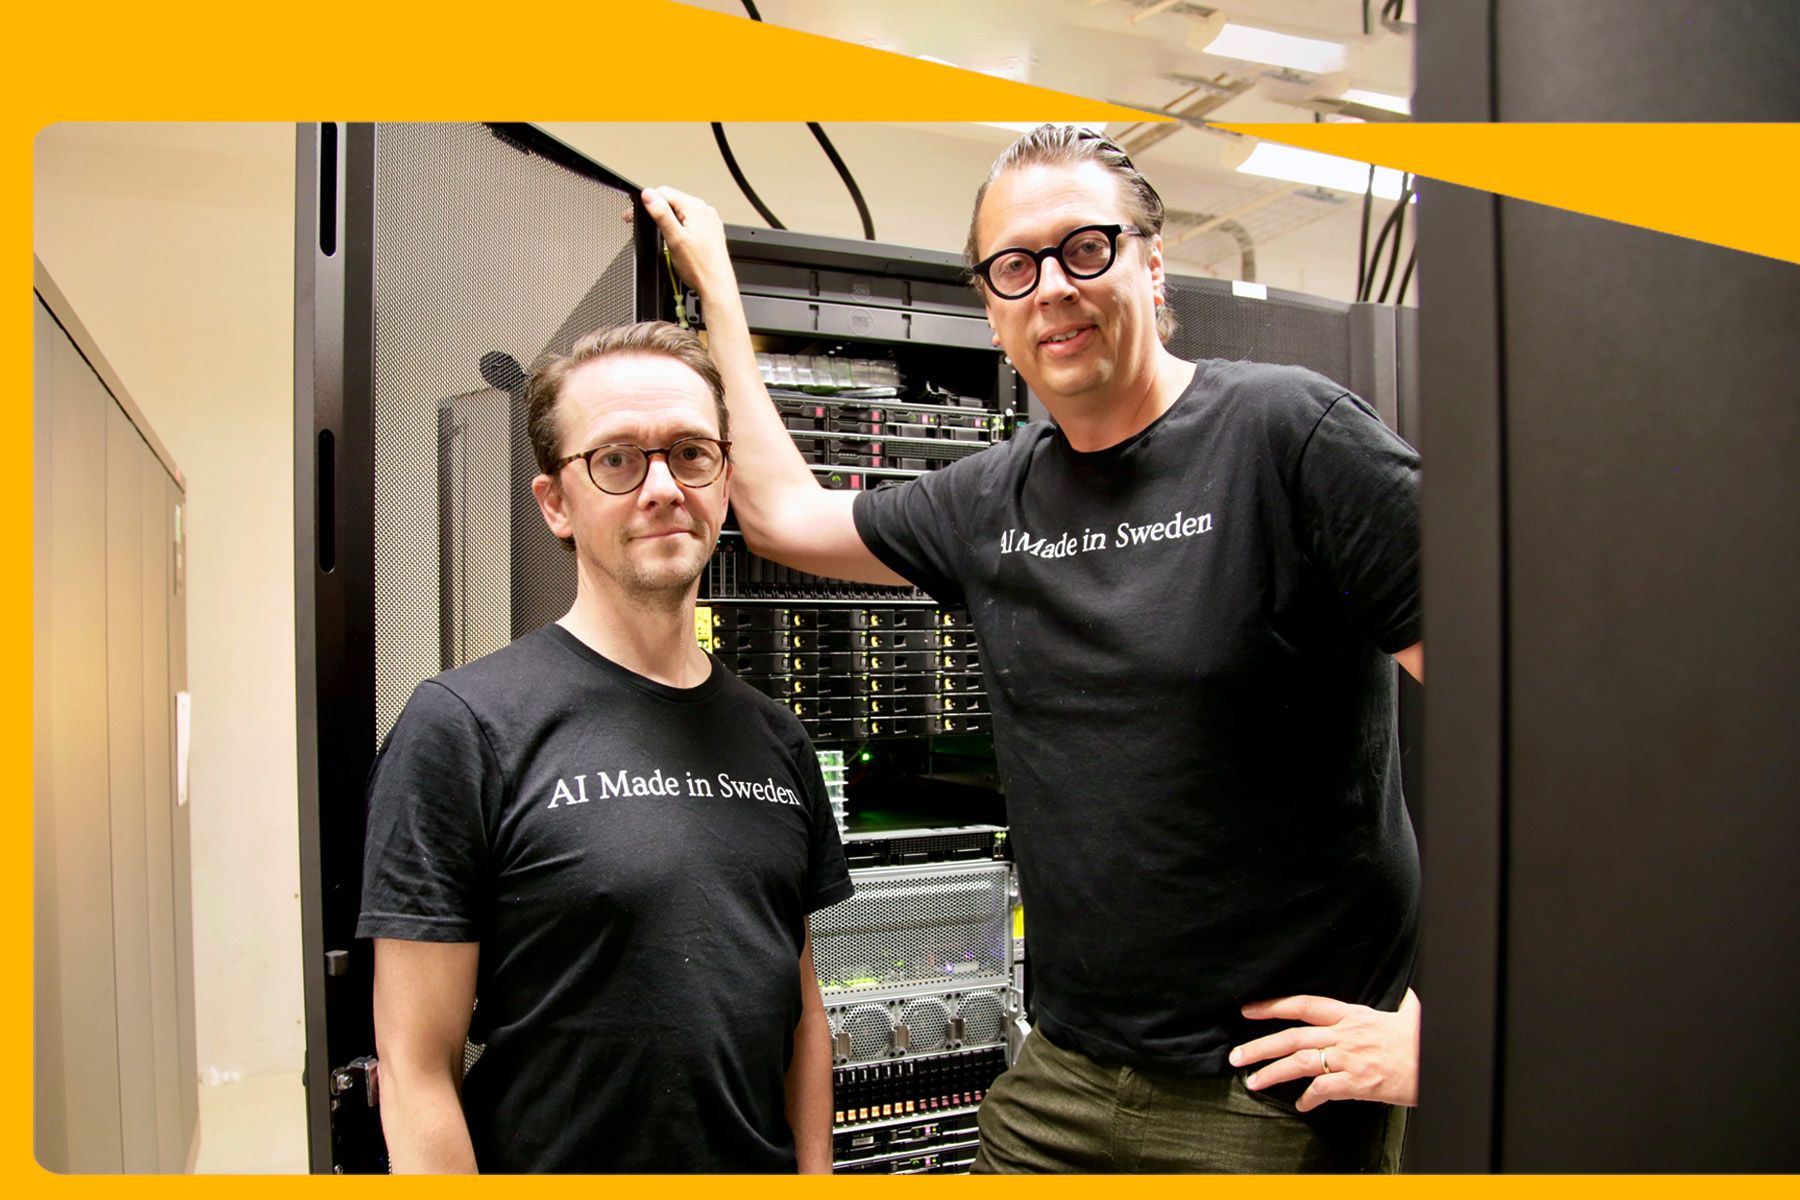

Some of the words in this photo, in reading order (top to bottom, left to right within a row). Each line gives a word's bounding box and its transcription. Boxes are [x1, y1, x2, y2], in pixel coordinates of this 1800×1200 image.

[1000, 529, 1016, 554] AI
[1015, 531, 1078, 559] Made
[1082, 528, 1106, 553] in
[1115, 511, 1213, 548] Sweden
[547, 774, 590, 809] AI
[597, 768, 680, 799] Made
[686, 771, 714, 798] in
[717, 773, 801, 806] Sweden
